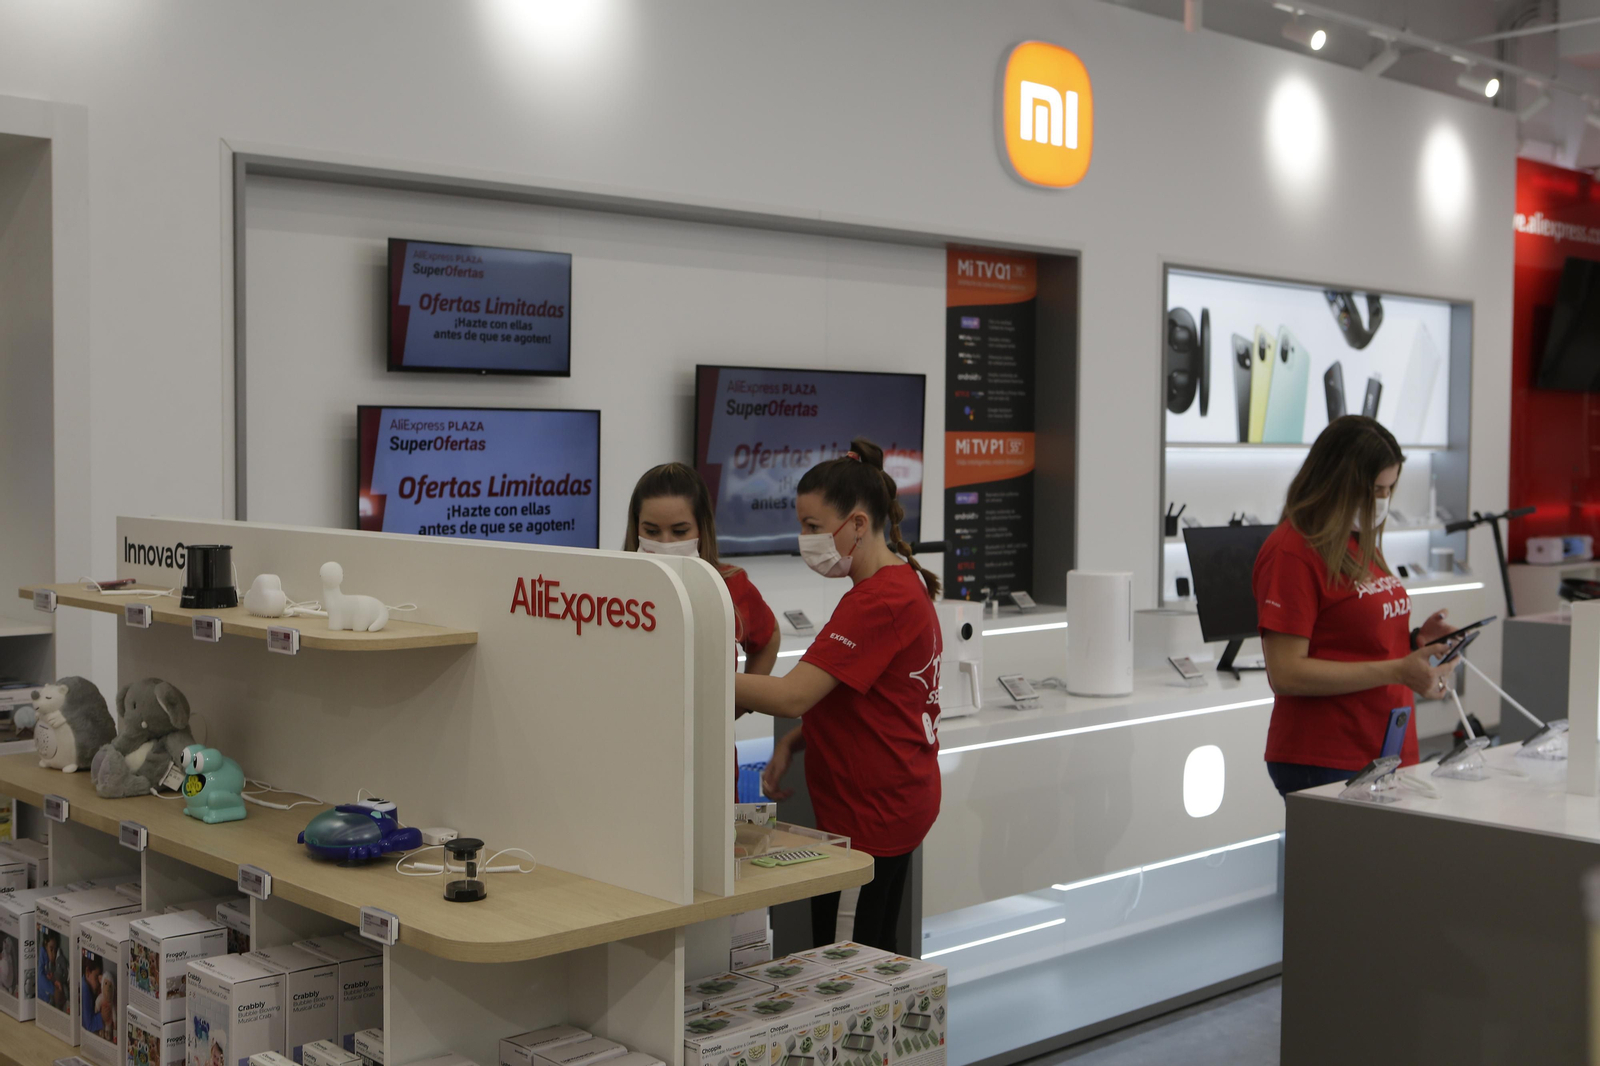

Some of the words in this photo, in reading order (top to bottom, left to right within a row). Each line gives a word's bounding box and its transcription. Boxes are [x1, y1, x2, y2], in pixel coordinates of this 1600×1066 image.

[413, 250, 454, 263] AliExpress
[456, 254, 482, 264] PLAZA
[413, 263, 484, 279] SuperOfertas
[958, 258, 974, 277] Mi
[975, 260, 995, 279] TV
[994, 262, 1011, 281] Q1
[419, 293, 480, 315] Ofertas
[485, 297, 565, 318] Limitadas
[454, 317, 488, 329] ¡Hazte
[490, 321, 507, 330] con
[510, 319, 533, 331] ellas
[434, 329, 462, 340] antes
[464, 330, 478, 341] de
[479, 333, 498, 343] que
[501, 334, 512, 342] se
[514, 333, 552, 345] agoten!
[726, 380, 780, 396] AliExpress
[782, 383, 817, 396] PLAZA
[726, 399, 818, 420] SuperOfertas
[390, 419, 445, 434] AliExpress
[448, 421, 484, 432] PLAZA
[390, 436, 486, 454] SuperOfertas
[955, 438, 970, 455] Mi
[972, 438, 988, 455] TV
[990, 439, 1004, 455] P1
[734, 441, 813, 475] Ofertas
[398, 474, 482, 505] Ofertas
[487, 473, 592, 498] Limitadas
[447, 505, 490, 520] ¡Hazte
[494, 506, 517, 517] con
[521, 502, 550, 516] ellas
[418, 522, 456, 535] antes
[460, 521, 477, 535] de
[480, 523, 503, 537] que
[509, 522, 523, 533] se
[526, 518, 575, 535] agoten!
[125, 536, 186, 570] InnovaG
[510, 574, 656, 636] AliExpress
[1383, 597, 1411, 620] PLAZA
[829, 632, 857, 650] EXPERT
[166, 951, 188, 959] Froggly
[344, 980, 370, 990] Crabbly
[893, 984, 910, 993] Choppie
[293, 990, 320, 1001] Crabbly
[238, 1001, 266, 1012] Crabbly
[832, 1003, 850, 1013] Choppie
[238, 1015, 258, 1025] Musical
[259, 1012, 272, 1020] Crab
[770, 1023, 789, 1033] Choppie
[701, 1044, 722, 1055] Choppie
